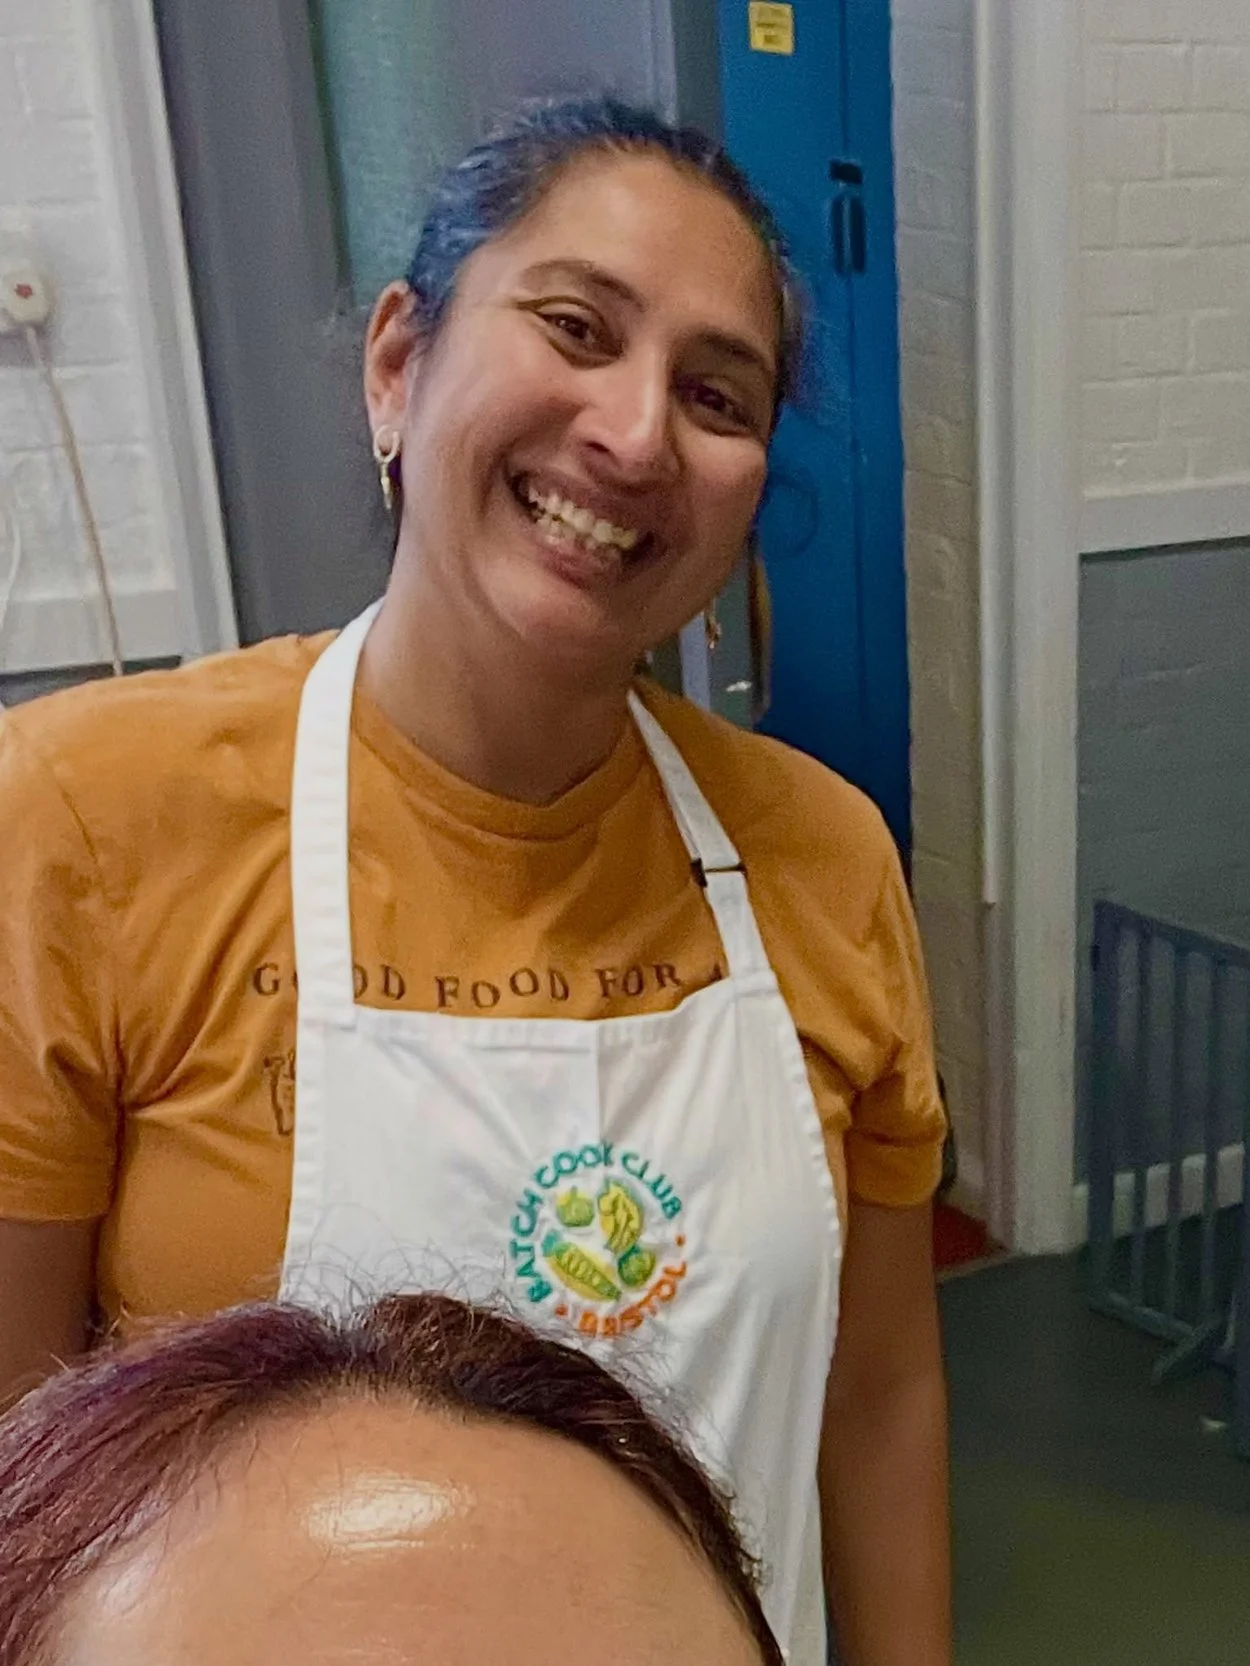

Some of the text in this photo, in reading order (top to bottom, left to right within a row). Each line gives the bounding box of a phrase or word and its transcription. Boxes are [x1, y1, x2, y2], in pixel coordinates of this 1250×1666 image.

[434, 967, 571, 1009] FOOD
[595, 962, 683, 997] FOR
[530, 1140, 615, 1190] COOK
[620, 1150, 684, 1221] CLUB
